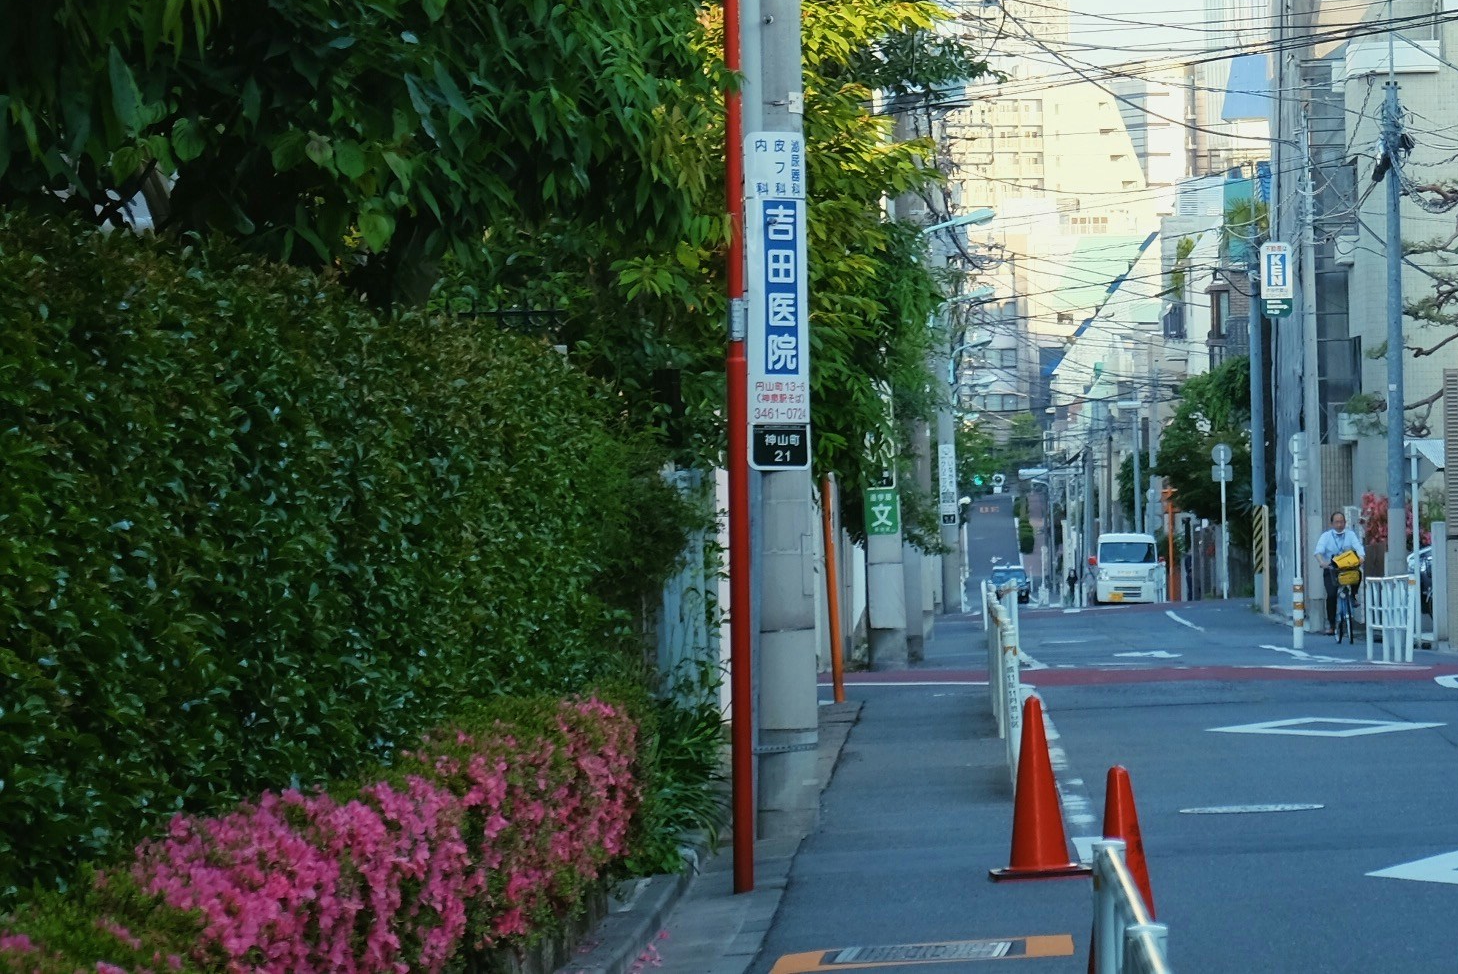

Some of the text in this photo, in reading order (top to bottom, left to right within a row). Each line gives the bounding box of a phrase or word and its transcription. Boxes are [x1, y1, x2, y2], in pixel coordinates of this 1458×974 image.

[1271, 255, 1283, 286] KEN
[766, 205, 796, 370] 吉田医院
[765, 434, 801, 447] 神山町
[774, 450, 791, 462] 21
[871, 503, 893, 528] 文
